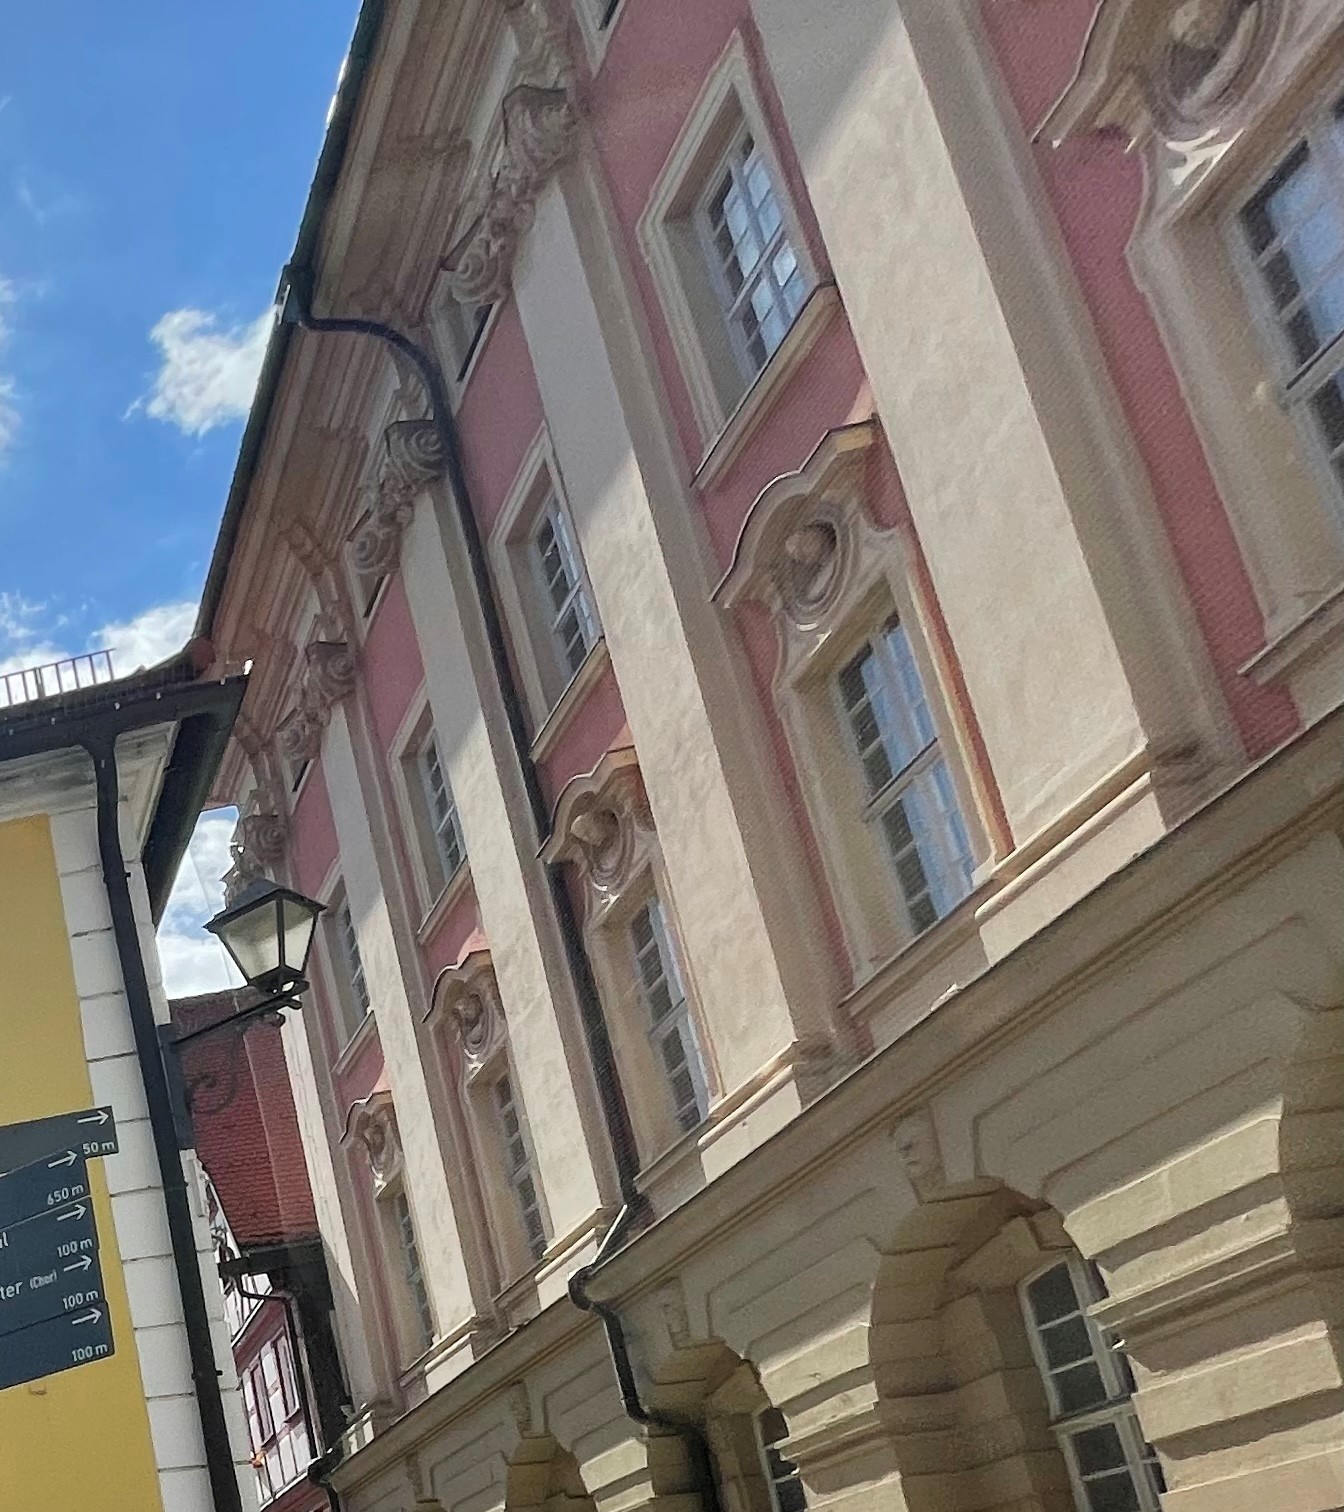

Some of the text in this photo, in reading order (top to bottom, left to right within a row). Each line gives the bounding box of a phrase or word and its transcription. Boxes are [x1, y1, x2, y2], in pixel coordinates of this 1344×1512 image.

[82, 1140, 115, 1156] 50 m
[46, 1183, 85, 1206] 650 m
[56, 1237, 93, 1259] 100 m
[62, 1289, 99, 1311] 100 m
[71, 1342, 108, 1362] 100 m
